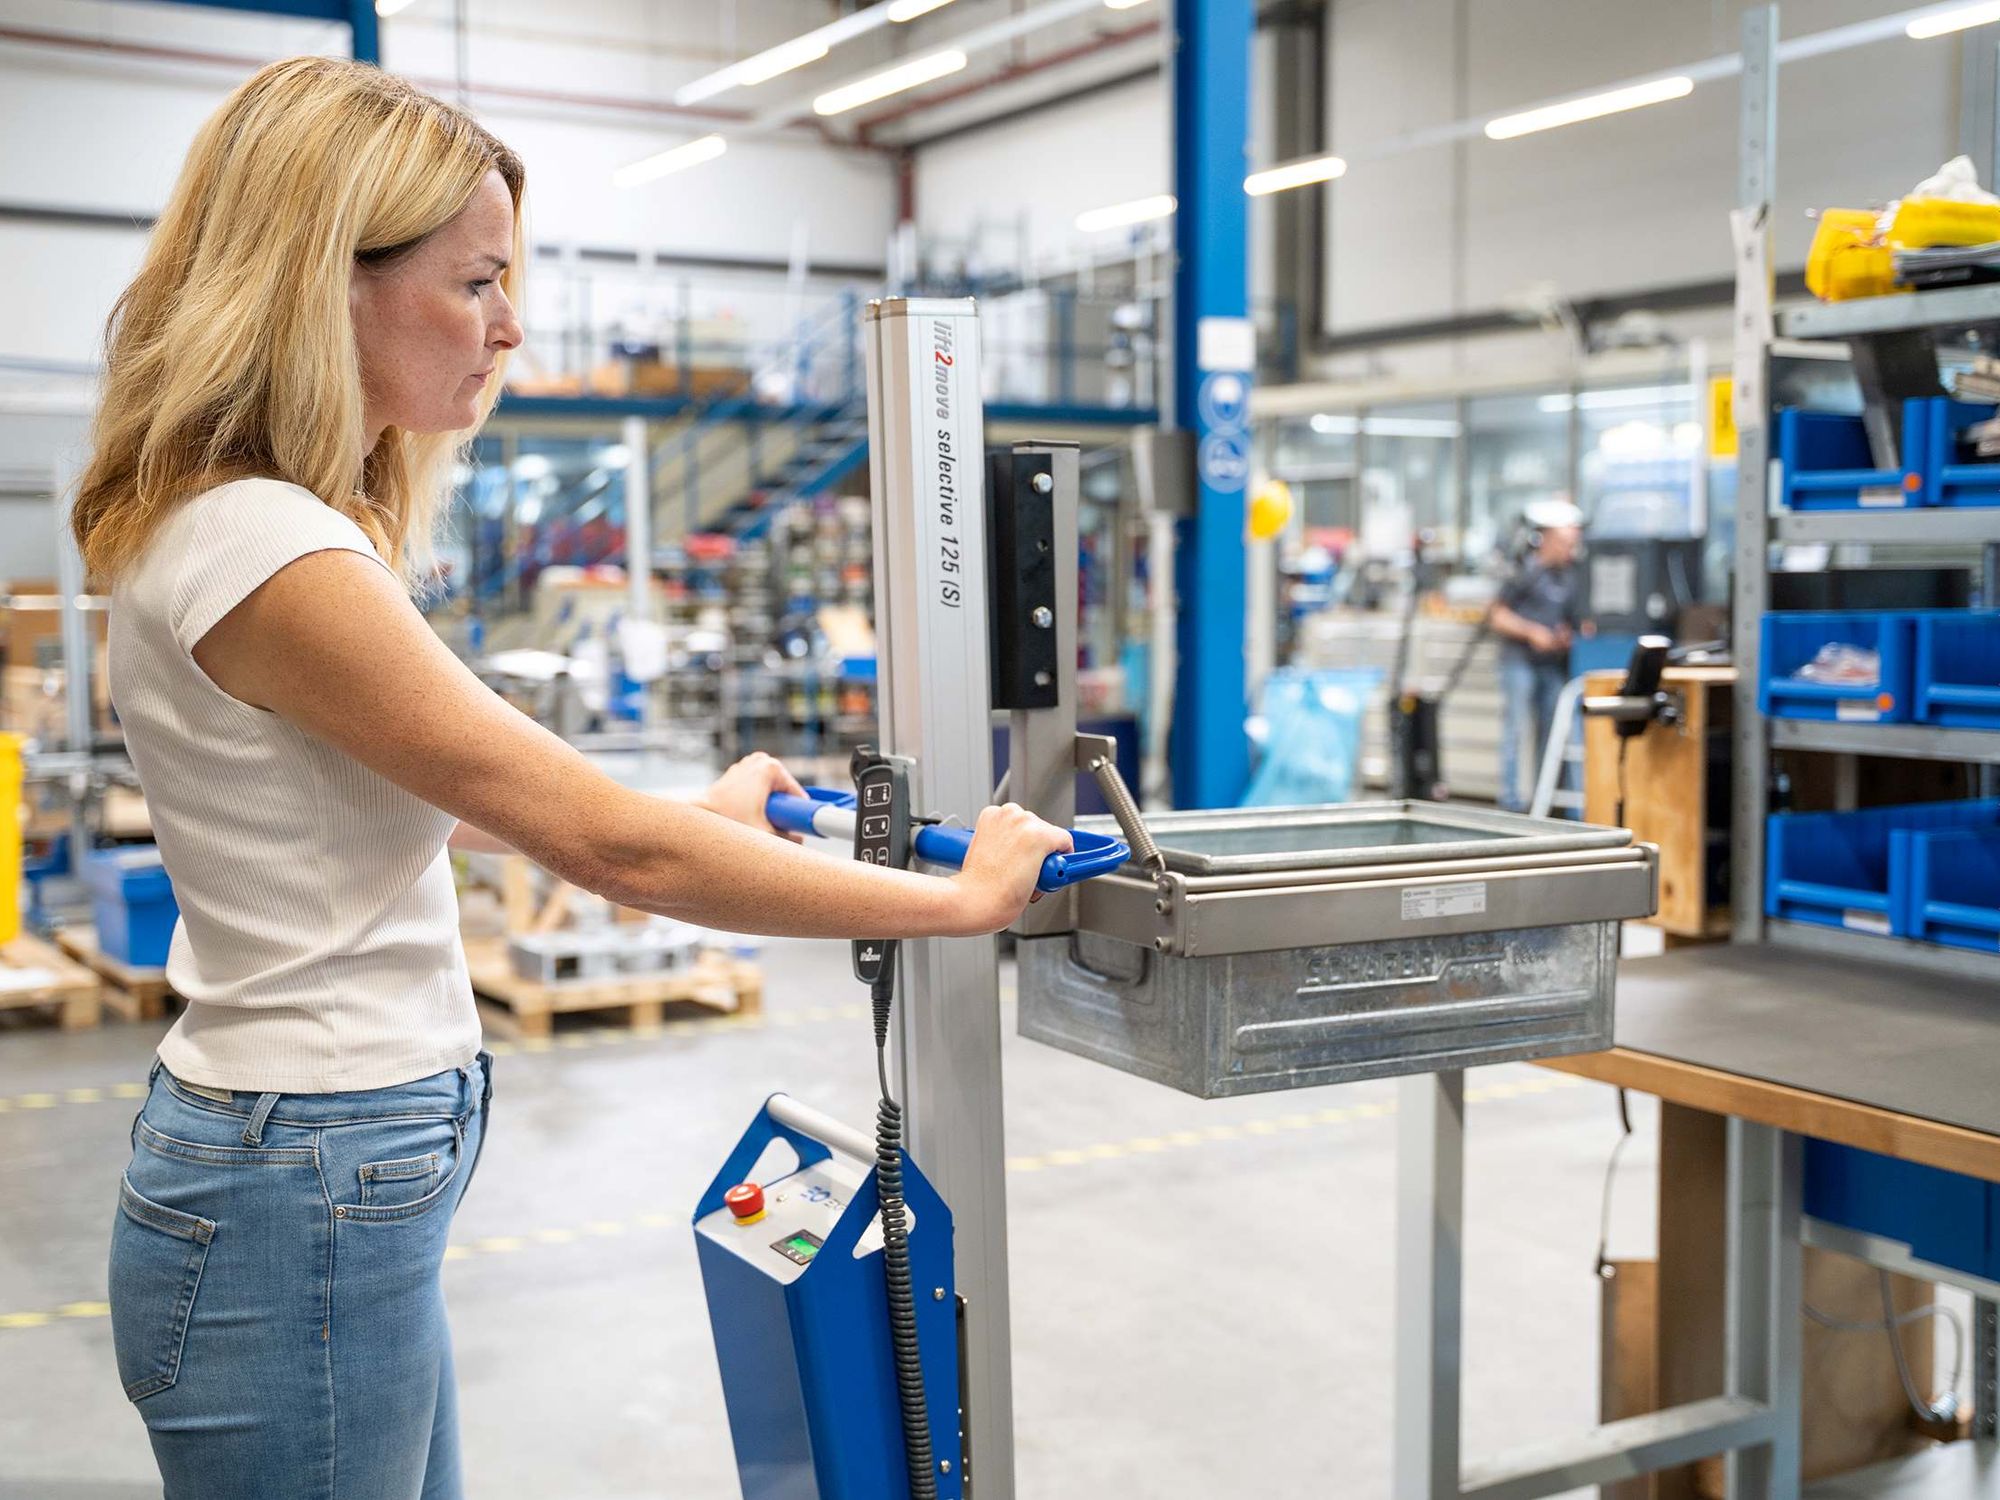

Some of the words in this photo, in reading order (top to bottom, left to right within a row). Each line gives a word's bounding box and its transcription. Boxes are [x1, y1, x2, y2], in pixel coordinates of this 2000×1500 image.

[933, 320, 953, 420] lift2move
[937, 429, 958, 526] selective
[940, 536, 960, 574] 125
[939, 580, 961, 608] (S)
